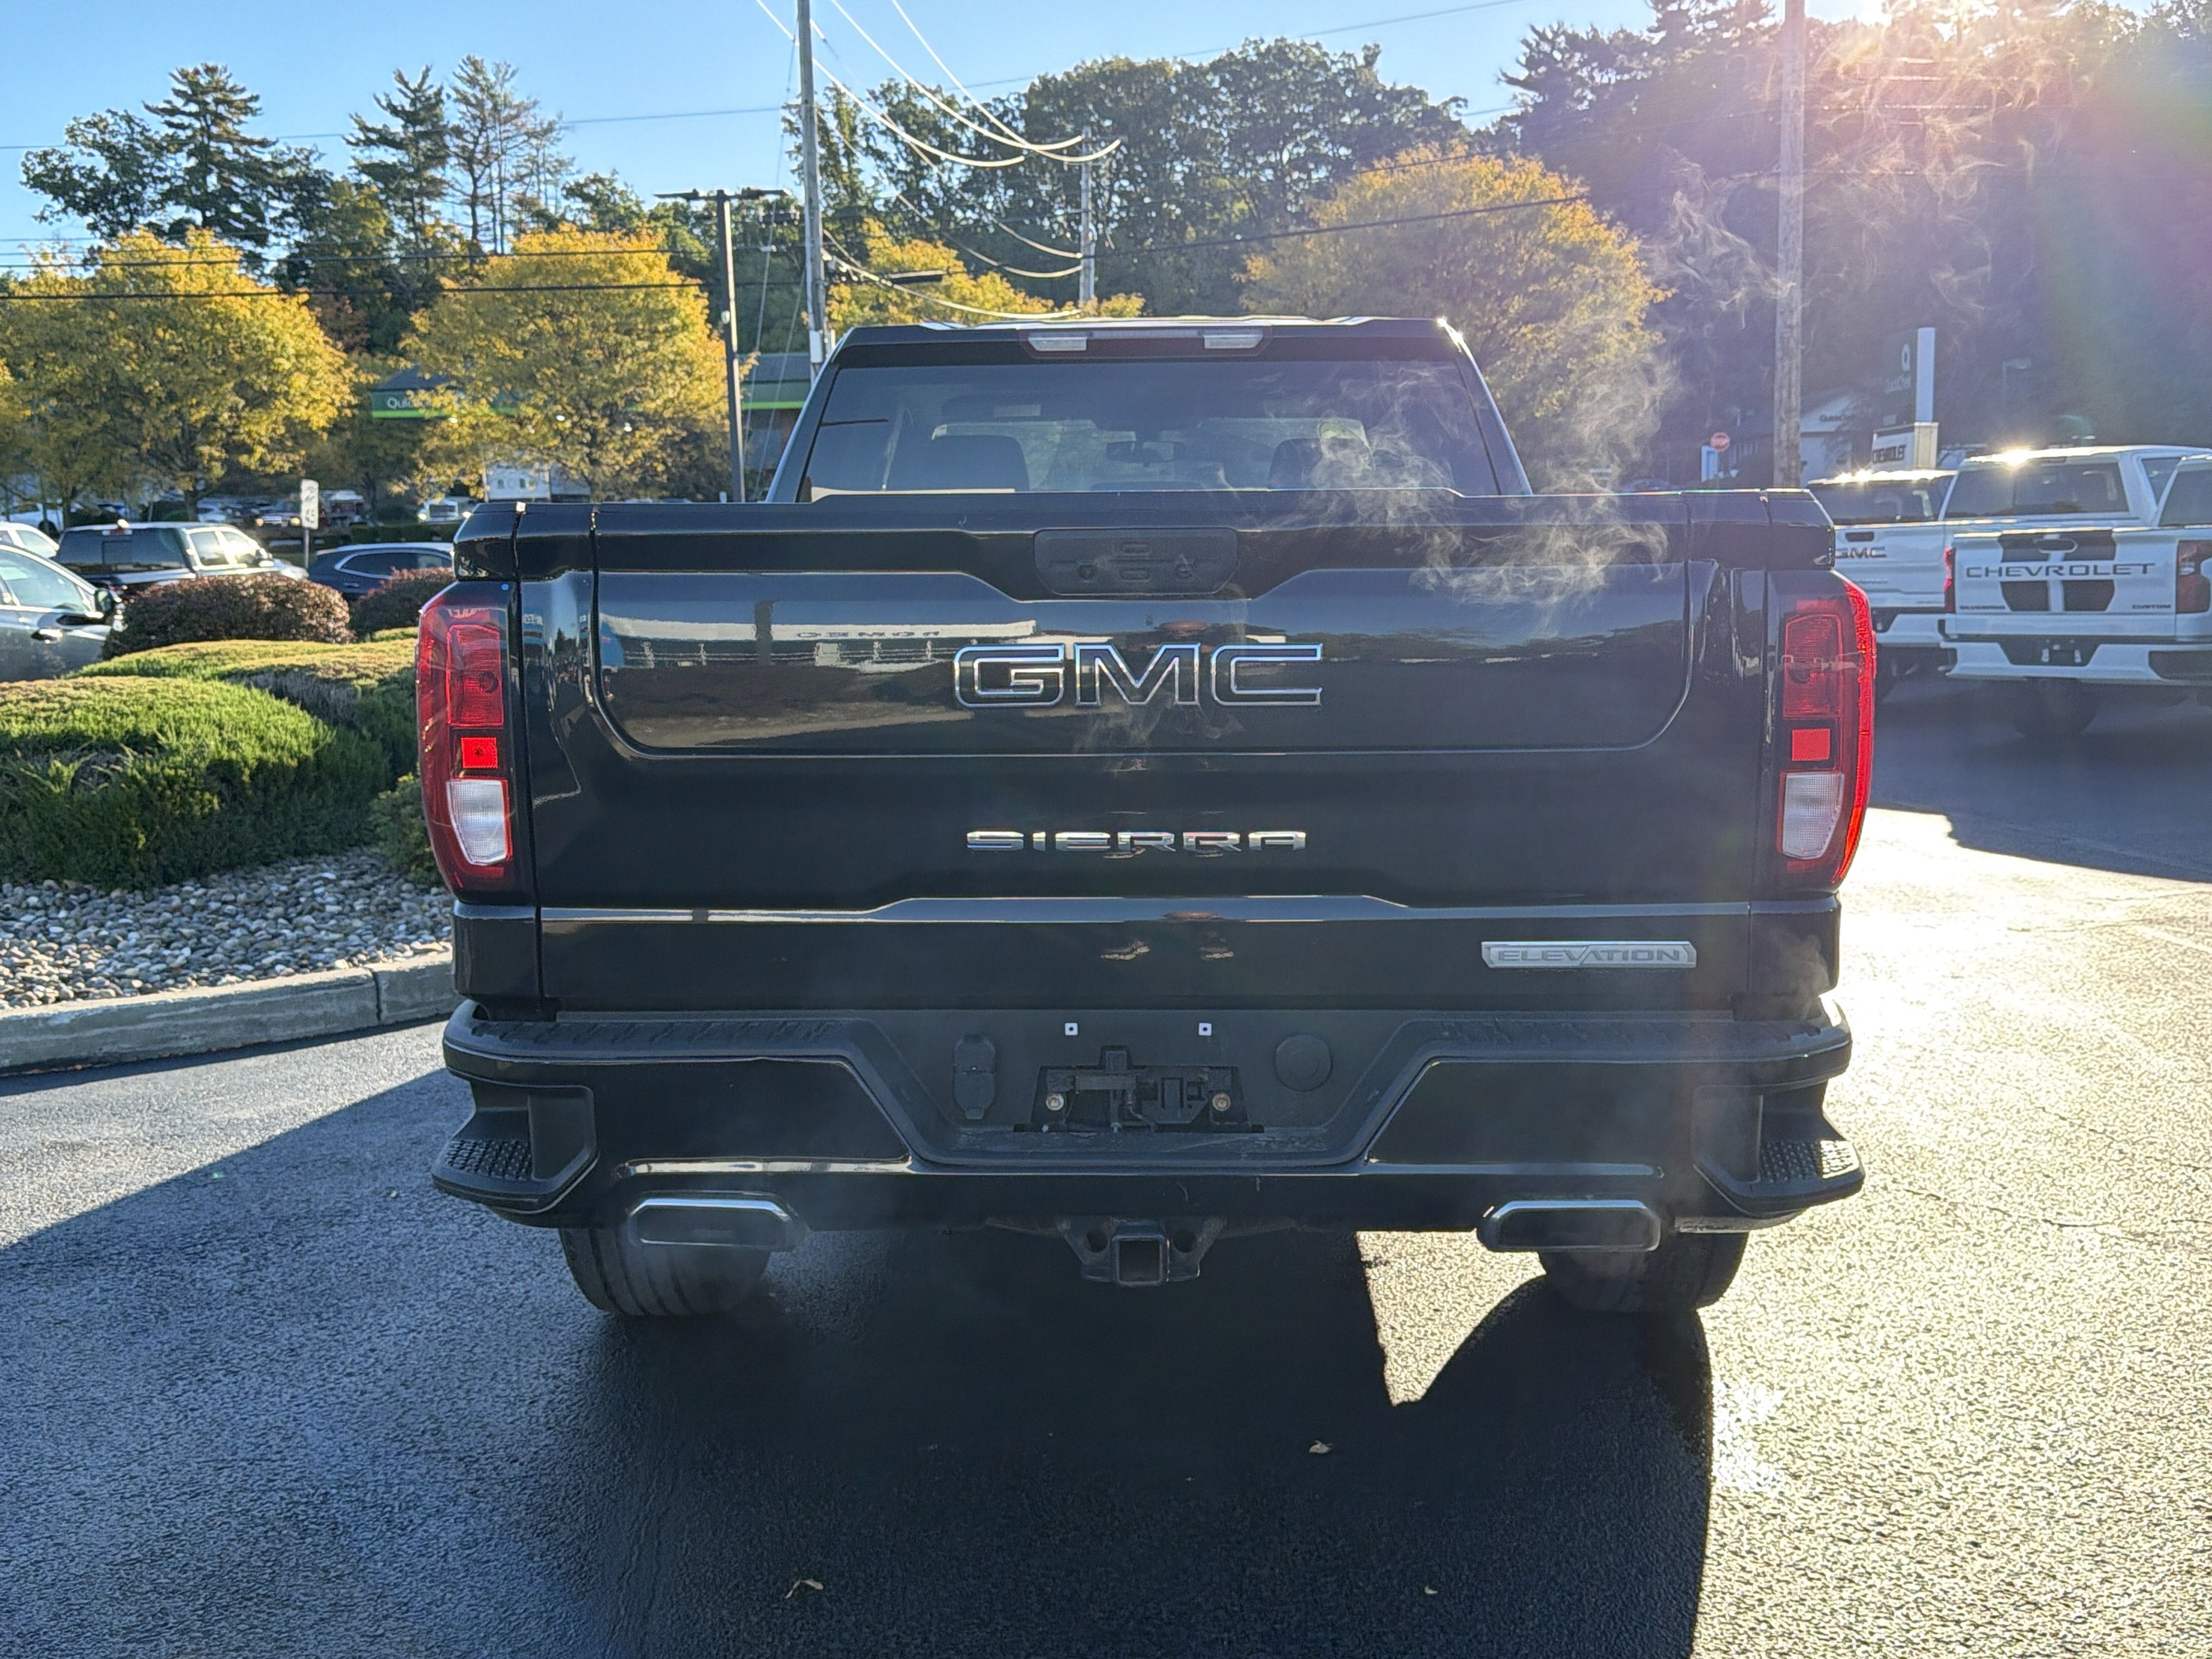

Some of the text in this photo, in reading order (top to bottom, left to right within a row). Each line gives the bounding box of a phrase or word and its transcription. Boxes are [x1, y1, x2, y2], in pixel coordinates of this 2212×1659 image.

[1836, 546, 1887, 558] GMC
[1966, 563, 2155, 578] CHEVROLET
[954, 642, 1323, 707] GMC
[966, 831, 1306, 852] SIERRA
[1498, 947, 1680, 961] ELEVATION
